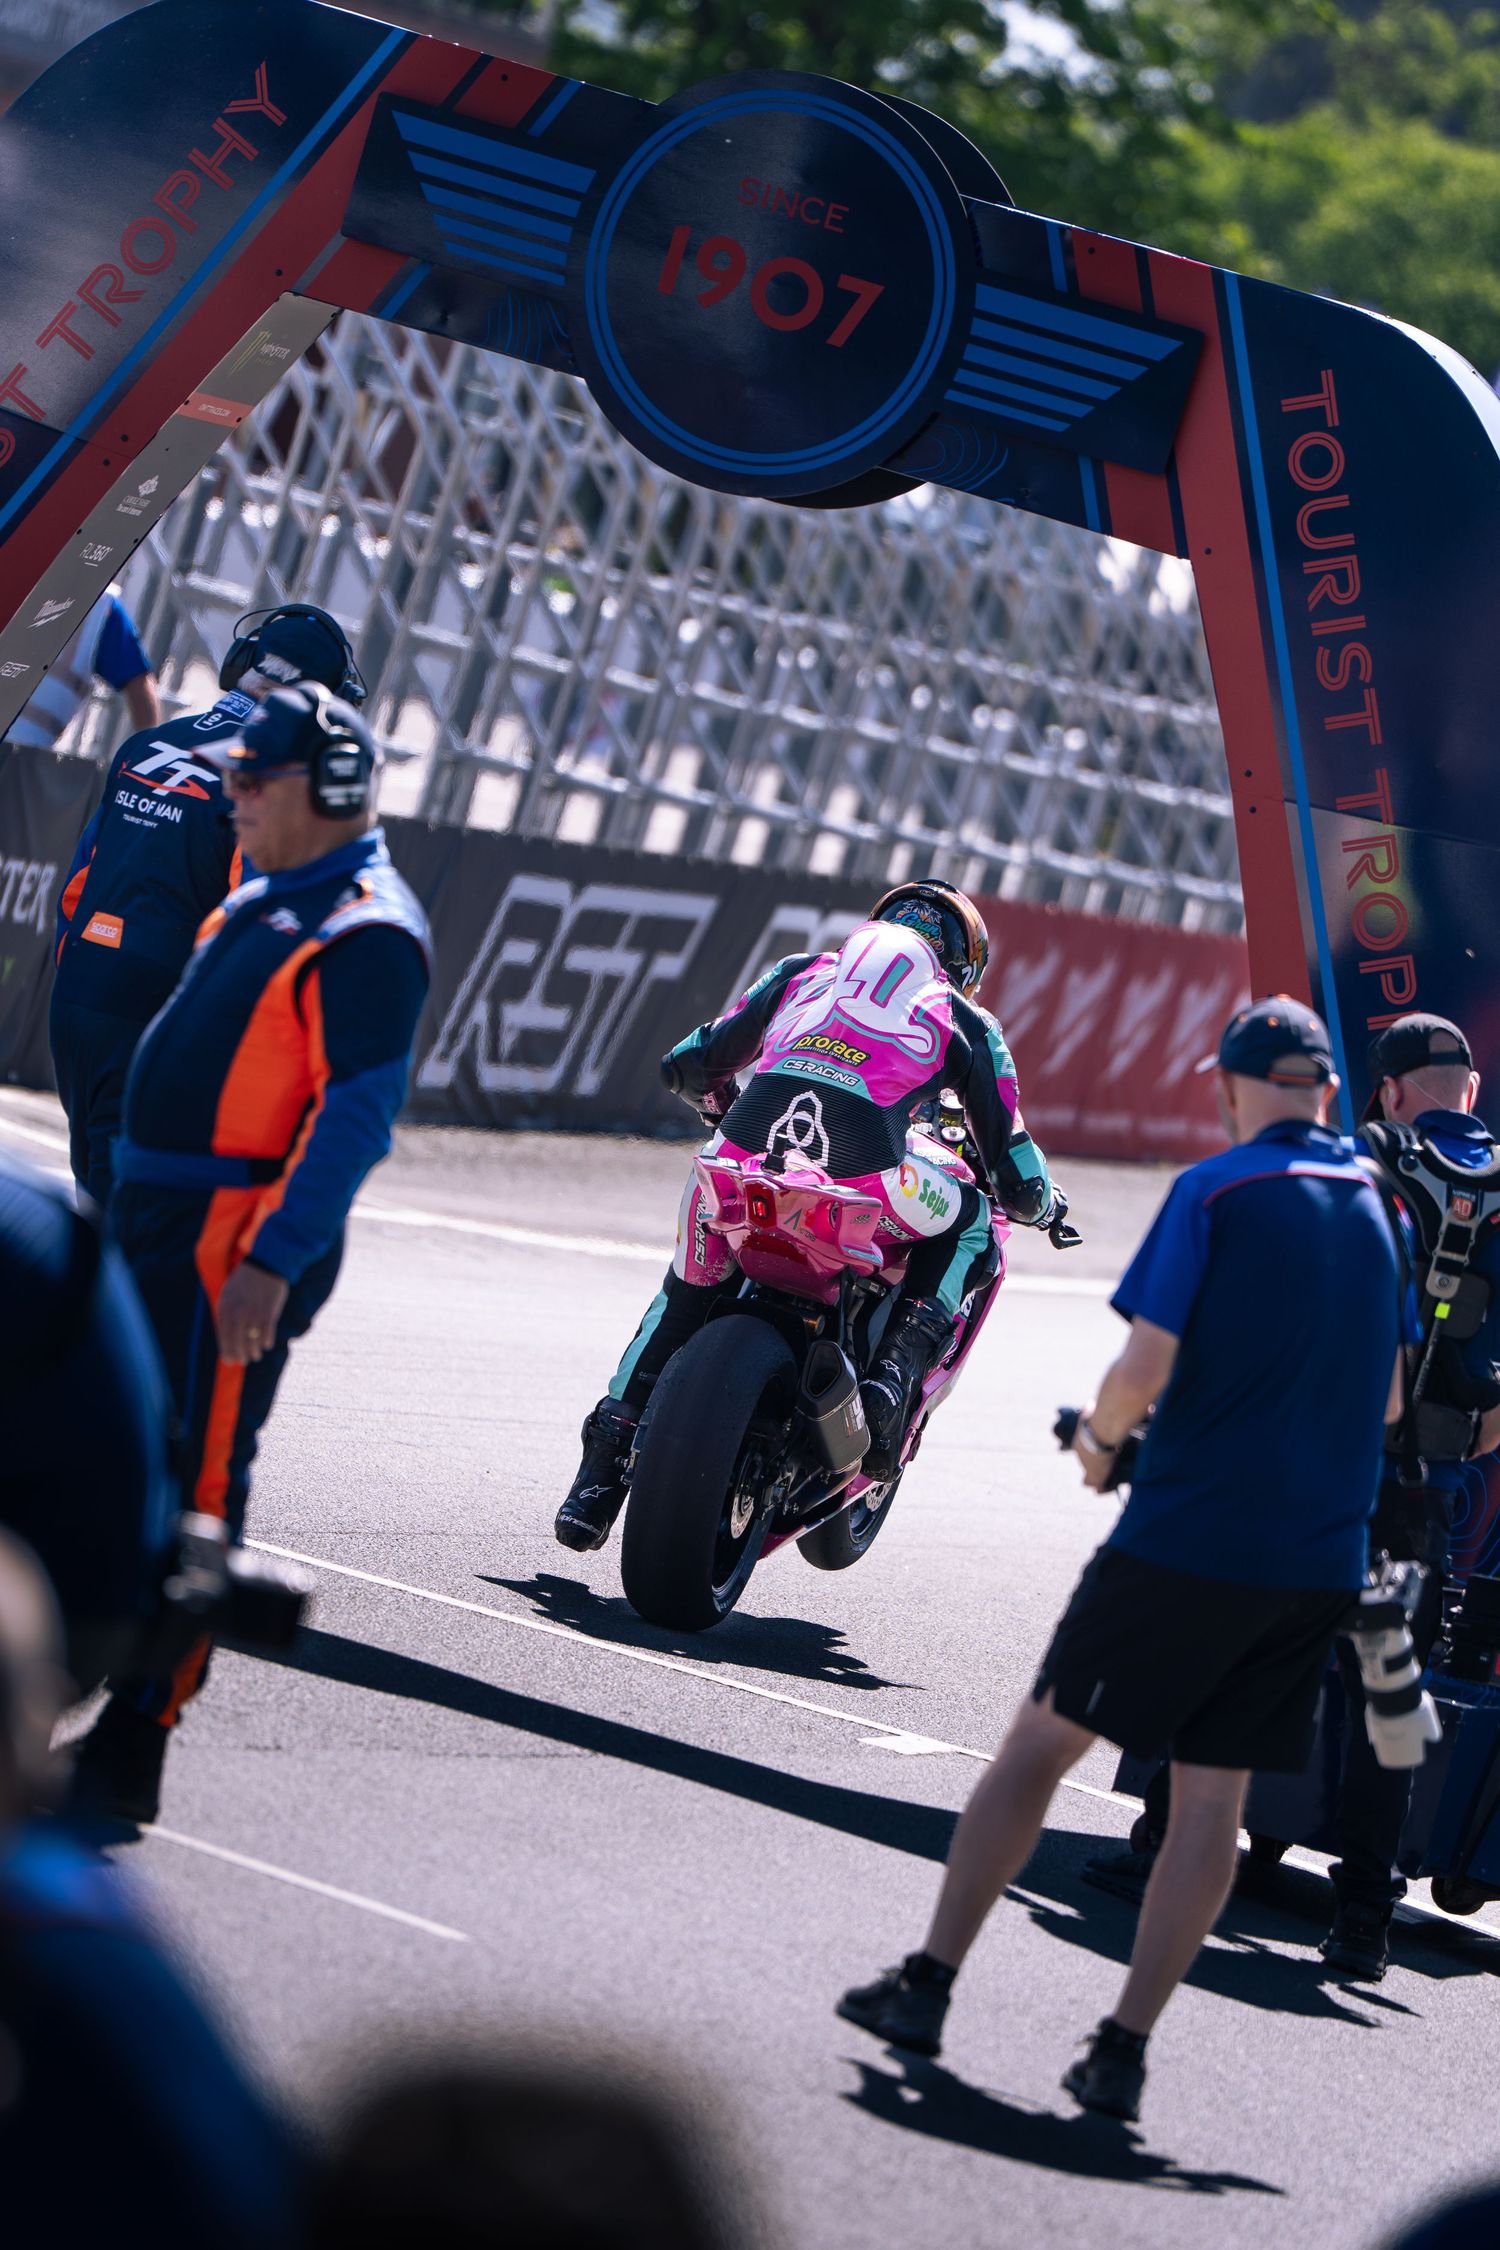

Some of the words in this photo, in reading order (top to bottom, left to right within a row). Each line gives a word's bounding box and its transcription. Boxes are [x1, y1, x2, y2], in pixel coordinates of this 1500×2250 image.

[35, 60, 288, 361] TROPHY
[736, 177, 849, 234] SINCE
[656, 224, 886, 349] 1907
[1281, 369, 1383, 746] TOURIST
[130, 740, 221, 796] TT
[114, 790, 135, 809] ISLE
[137, 798, 156, 815] OF
[154, 801, 183, 824] MAN
[0, 850, 58, 935] TER
[782, 1058, 859, 1087] CSRACING
[792, 1035, 868, 1063] prorace
